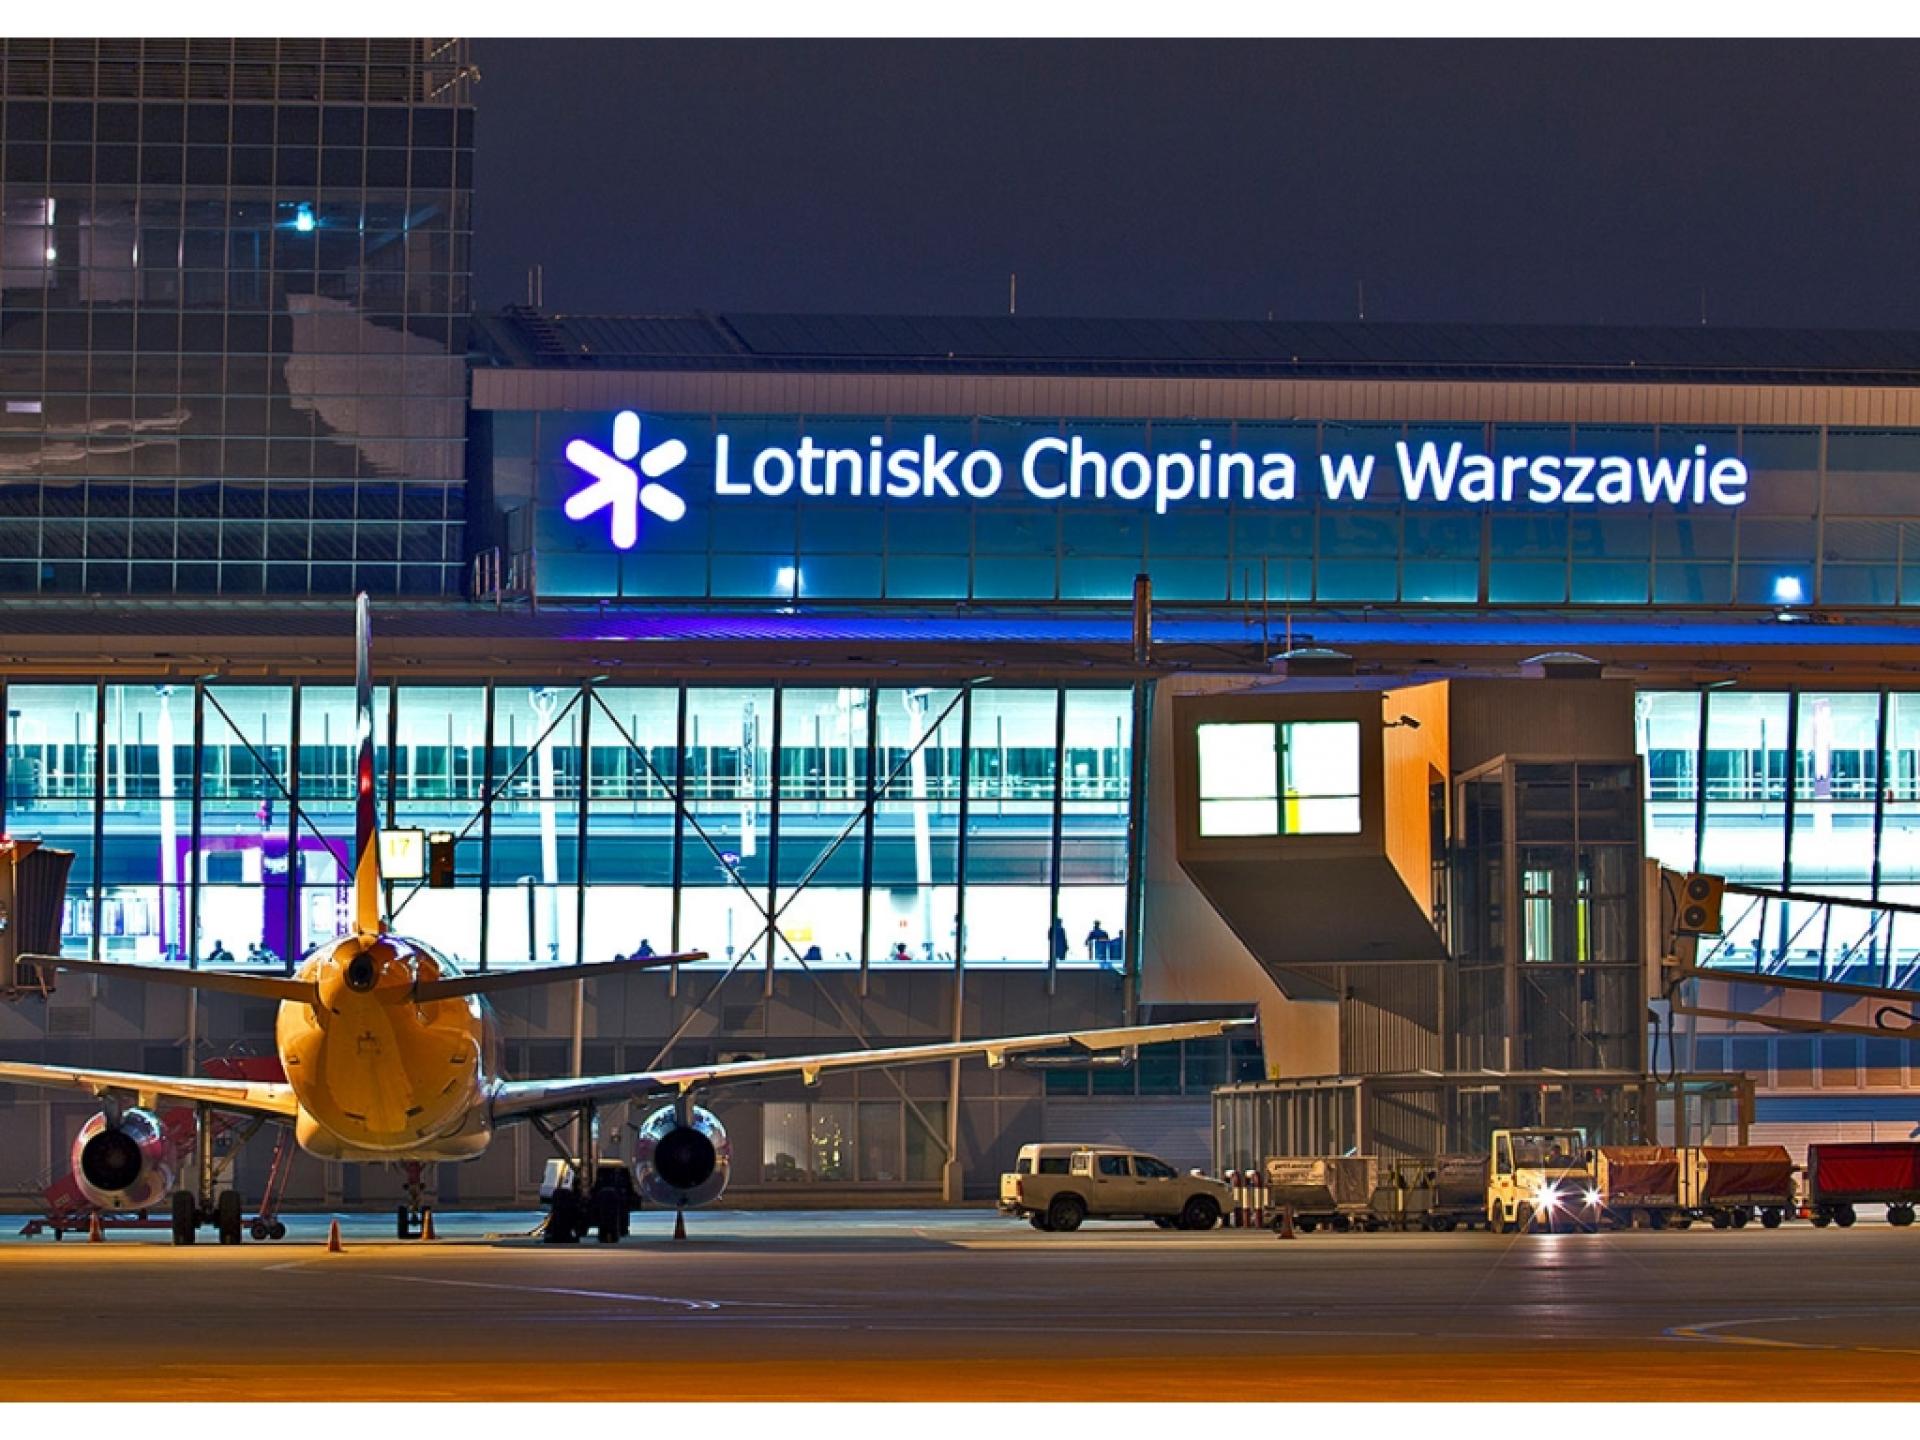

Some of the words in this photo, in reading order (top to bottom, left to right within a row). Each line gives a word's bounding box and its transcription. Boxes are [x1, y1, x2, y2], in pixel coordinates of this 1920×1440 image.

[714, 433, 1002, 499] Lotnisko
[1021, 436, 1296, 516] Chopina
[1320, 454, 1375, 501] w
[1396, 441, 1749, 506] Warszawie
